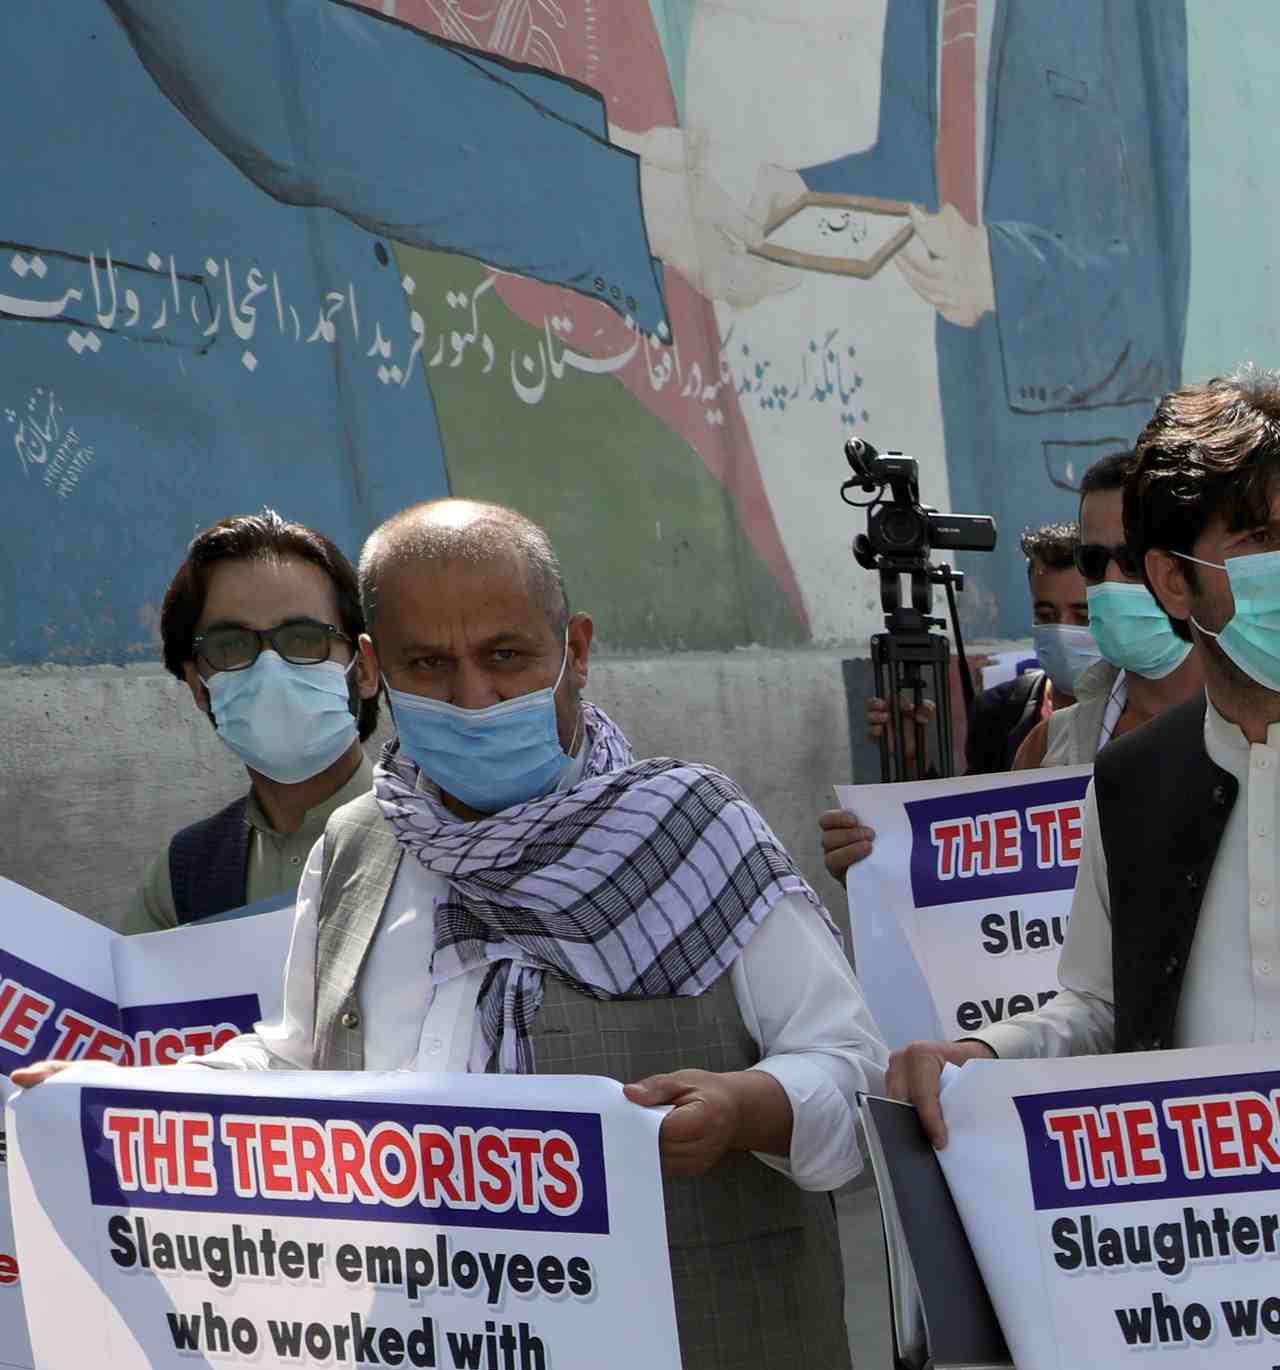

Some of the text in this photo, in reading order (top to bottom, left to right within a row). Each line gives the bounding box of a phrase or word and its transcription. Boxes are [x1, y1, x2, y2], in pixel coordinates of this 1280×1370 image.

[306, 281, 360, 344] احمد
[366, 273, 425, 388] فرید
[511, 313, 682, 405] افغانستان
[934, 814, 1019, 876] THE
[107, 1114, 578, 1209] THE TERRORISTS
[1048, 1107, 1163, 1183] THE
[108, 1215, 591, 1304] Slaughter employees
[1052, 1208, 1278, 1275] Slaughter
[166, 1303, 257, 1353] who
[268, 1313, 435, 1367] worked
[1115, 1293, 1211, 1344] who
